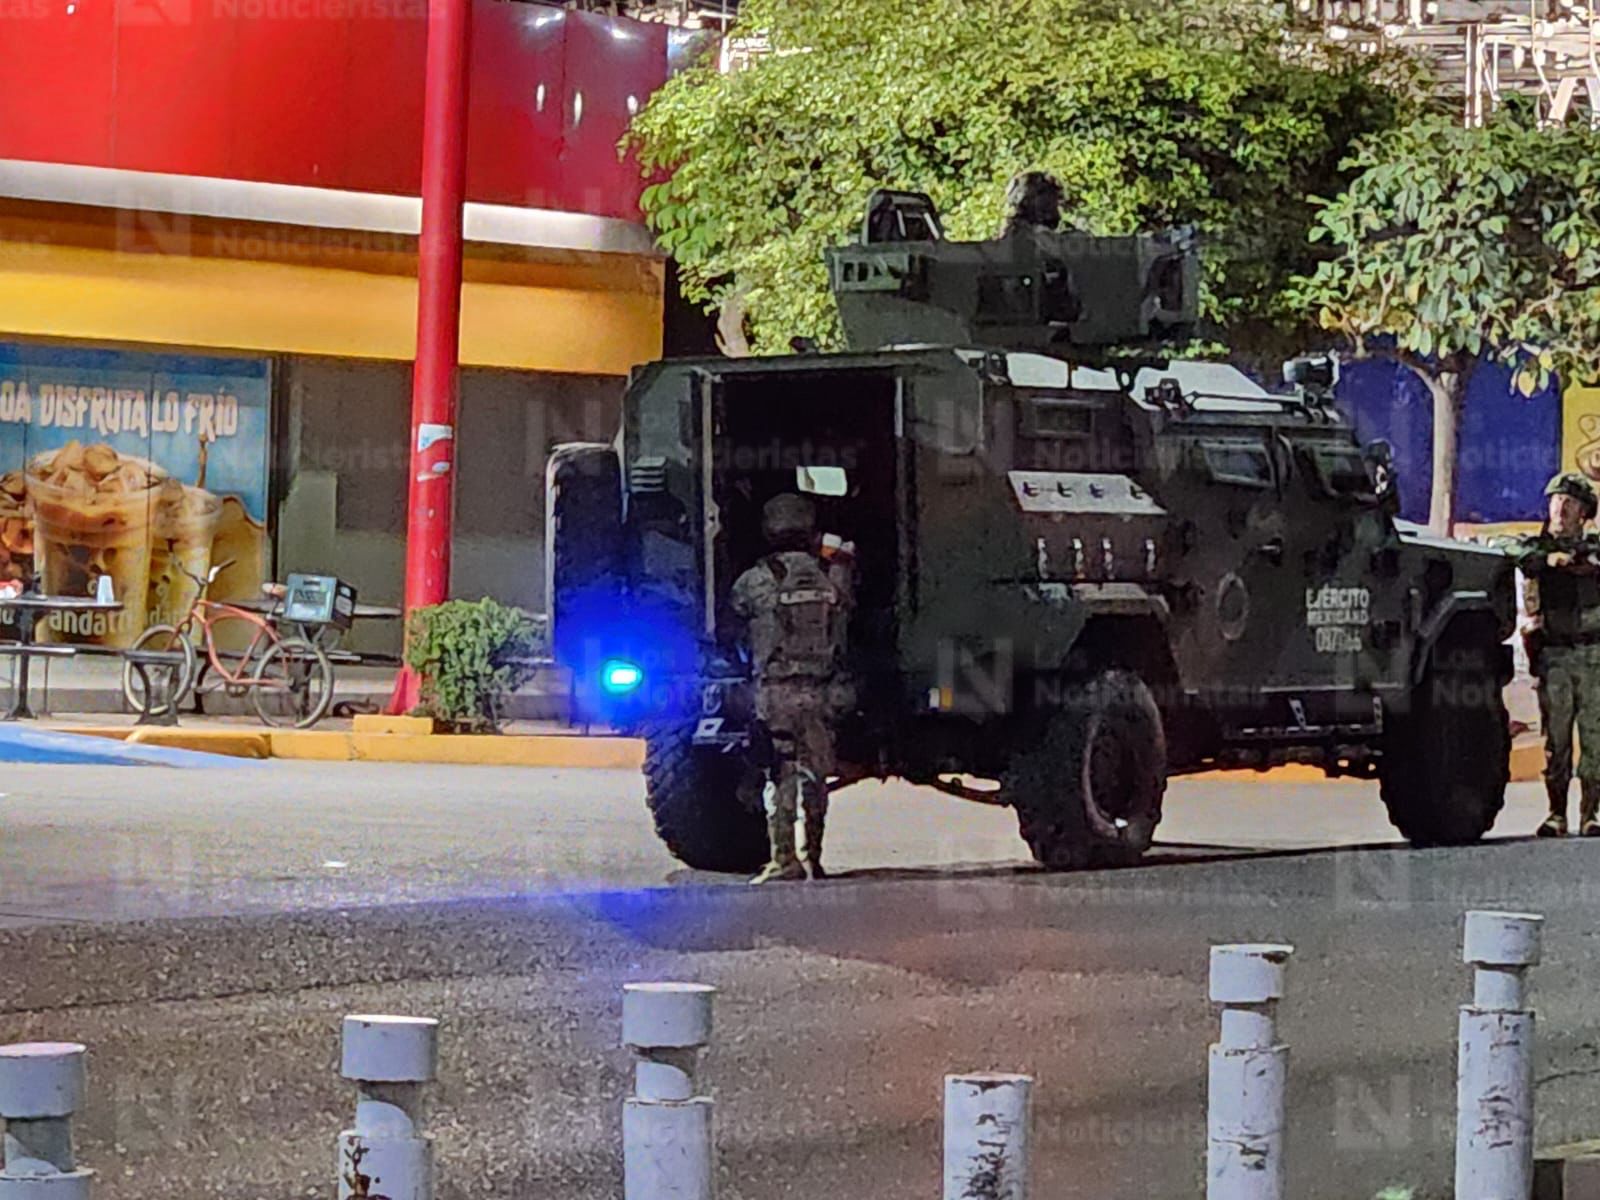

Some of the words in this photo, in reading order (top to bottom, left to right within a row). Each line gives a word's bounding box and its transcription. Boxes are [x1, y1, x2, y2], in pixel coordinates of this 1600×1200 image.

[40, 383, 148, 438] DISFRUTA
[152, 389, 180, 433] LO
[184, 386, 239, 443] FRÍO
